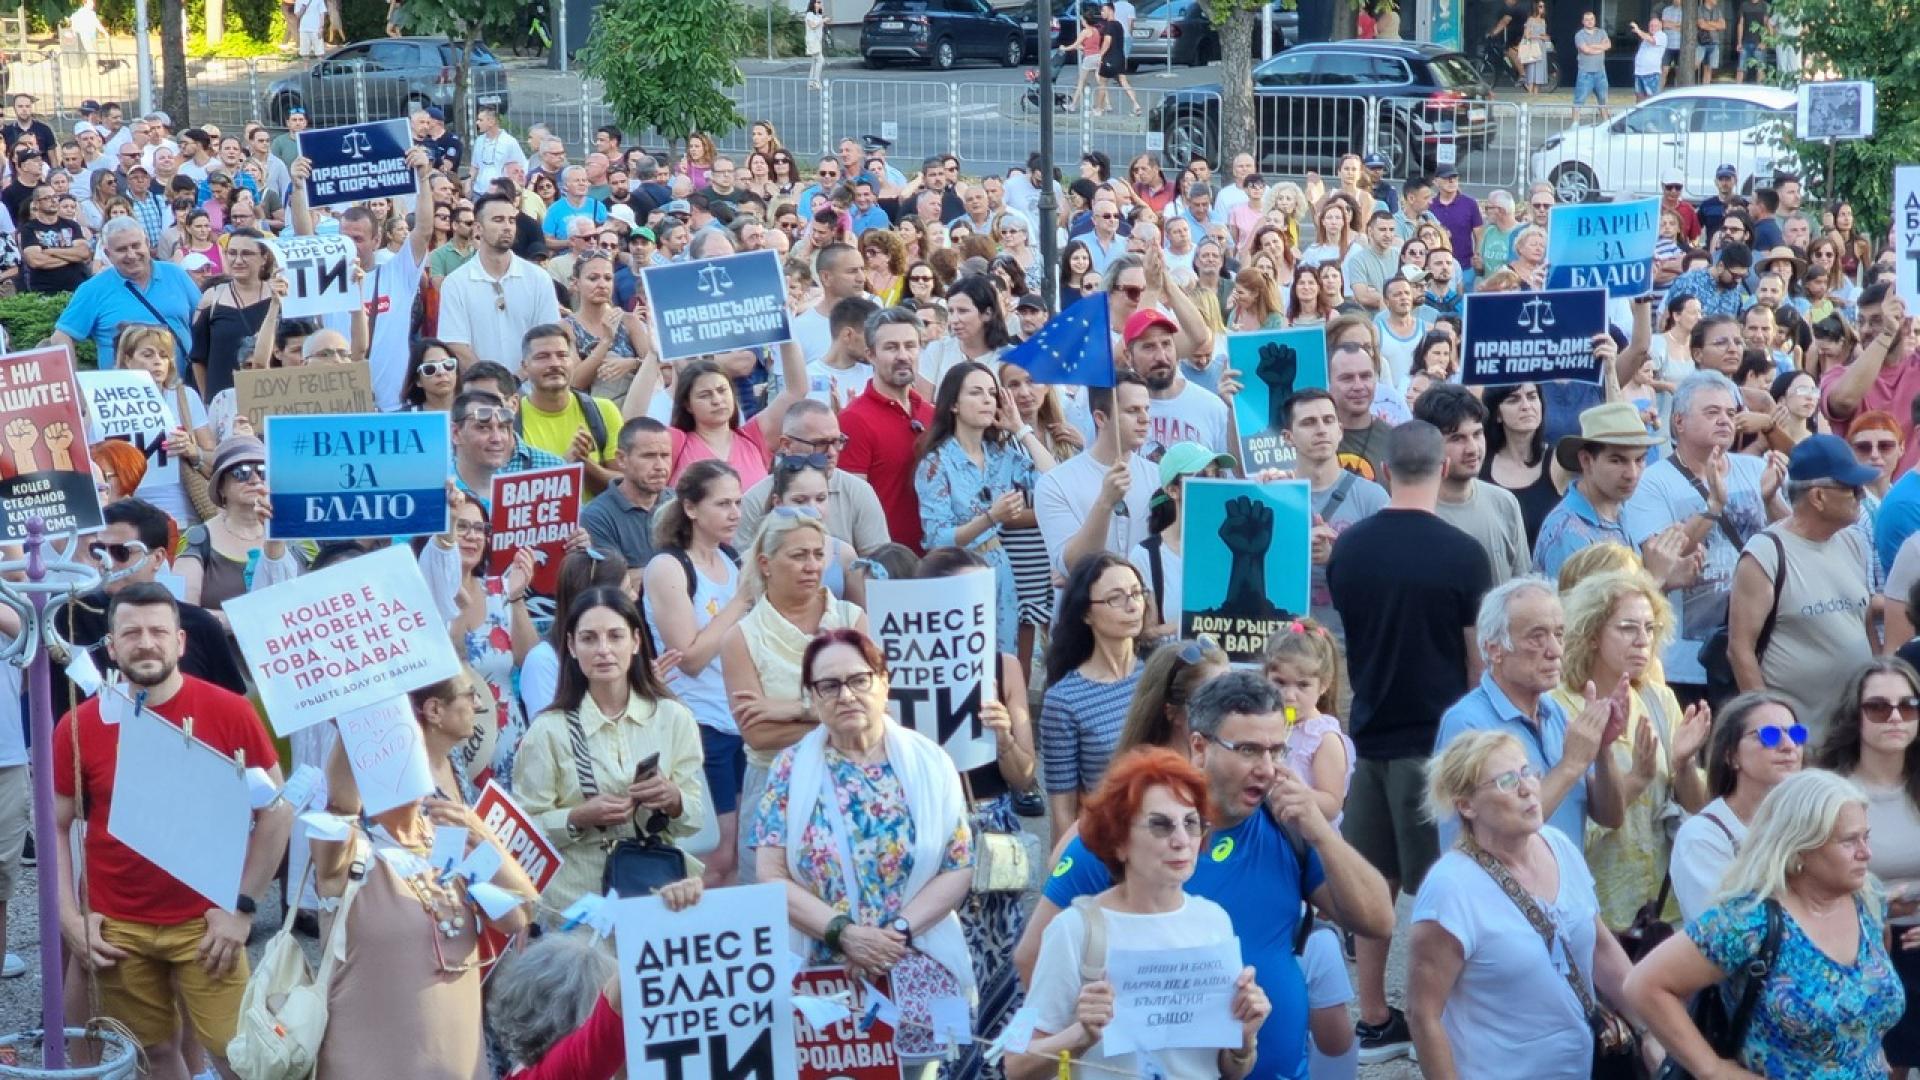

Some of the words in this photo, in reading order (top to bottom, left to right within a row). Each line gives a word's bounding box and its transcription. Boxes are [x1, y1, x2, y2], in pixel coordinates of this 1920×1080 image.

[316, 181, 336, 196] НЕ
[340, 171, 411, 192] ПОРЪЧКИ!
[282, 246, 321, 259] УТРЕ
[324, 243, 347, 256] СИ
[1596, 240, 1625, 261] ЗА
[286, 255, 348, 298] ТИ
[1571, 261, 1645, 288] БЛАГО
[663, 294, 784, 326] ПРАВОСЪДИЕ,
[670, 326, 694, 345] НЕ
[698, 312, 783, 340] ПОРЪЧКИ!
[10, 361, 42, 385] НИ
[1475, 359, 1500, 375] НЕ
[1505, 354, 1595, 373] ПОРЪЧКИ!
[94, 386, 141, 403] ДНЕС
[143, 386, 155, 398] Е
[97, 400, 162, 419] БЛАГО
[101, 418, 140, 435] УТРЕ
[143, 415, 165, 430] СИ
[292, 429, 425, 458] #ВАРНА
[1249, 436, 1276, 449] ДОЛУ
[1253, 451, 1271, 465] ОТ
[12, 479, 51, 496] КОЦЕВ
[339, 463, 379, 490] ЗА
[502, 474, 573, 507] ВАРНА
[3, 490, 66, 511] СТЕФАНОВ
[304, 493, 416, 523] БЛАГО
[507, 505, 532, 529] НЕ
[537, 500, 562, 524] СЕ
[7, 526, 17, 538] С
[492, 522, 576, 552] ПРОДАВА!
[281, 591, 356, 629] КОЦЕВ
[361, 585, 375, 602] Е
[880, 608, 965, 636] ДНЕС
[973, 603, 985, 627] Е
[266, 609, 373, 656] ВИНОВЕН
[377, 598, 407, 619] ЗА
[1192, 616, 1233, 632] ДОЛУ
[259, 648, 327, 679] ТОВА,
[330, 634, 359, 653] ЧЕ
[362, 623, 393, 645] НЕ
[397, 611, 427, 633] СЕ
[883, 631, 986, 662] БЛАГО
[293, 638, 410, 690] ПРОДАВА!
[888, 665, 946, 685] УТРЕ
[953, 659, 984, 682] СИ
[343, 679, 371, 697] ДОЛУ
[372, 672, 388, 684] ОТ
[888, 678, 982, 746] ТИ
[484, 801, 549, 888] ВАРНА
[635, 931, 743, 975] ДНЕС
[753, 926, 773, 957] Е
[640, 962, 775, 1009] БЛАГО
[1122, 980, 1161, 991] ВАРНА
[640, 1007, 719, 1039] УТРЕ
[728, 999, 774, 1028] СИ
[1147, 1011, 1194, 1027] СЪЩО!
[644, 1027, 775, 1080] ТИ
[798, 1042, 895, 1072] РОДАВА!
